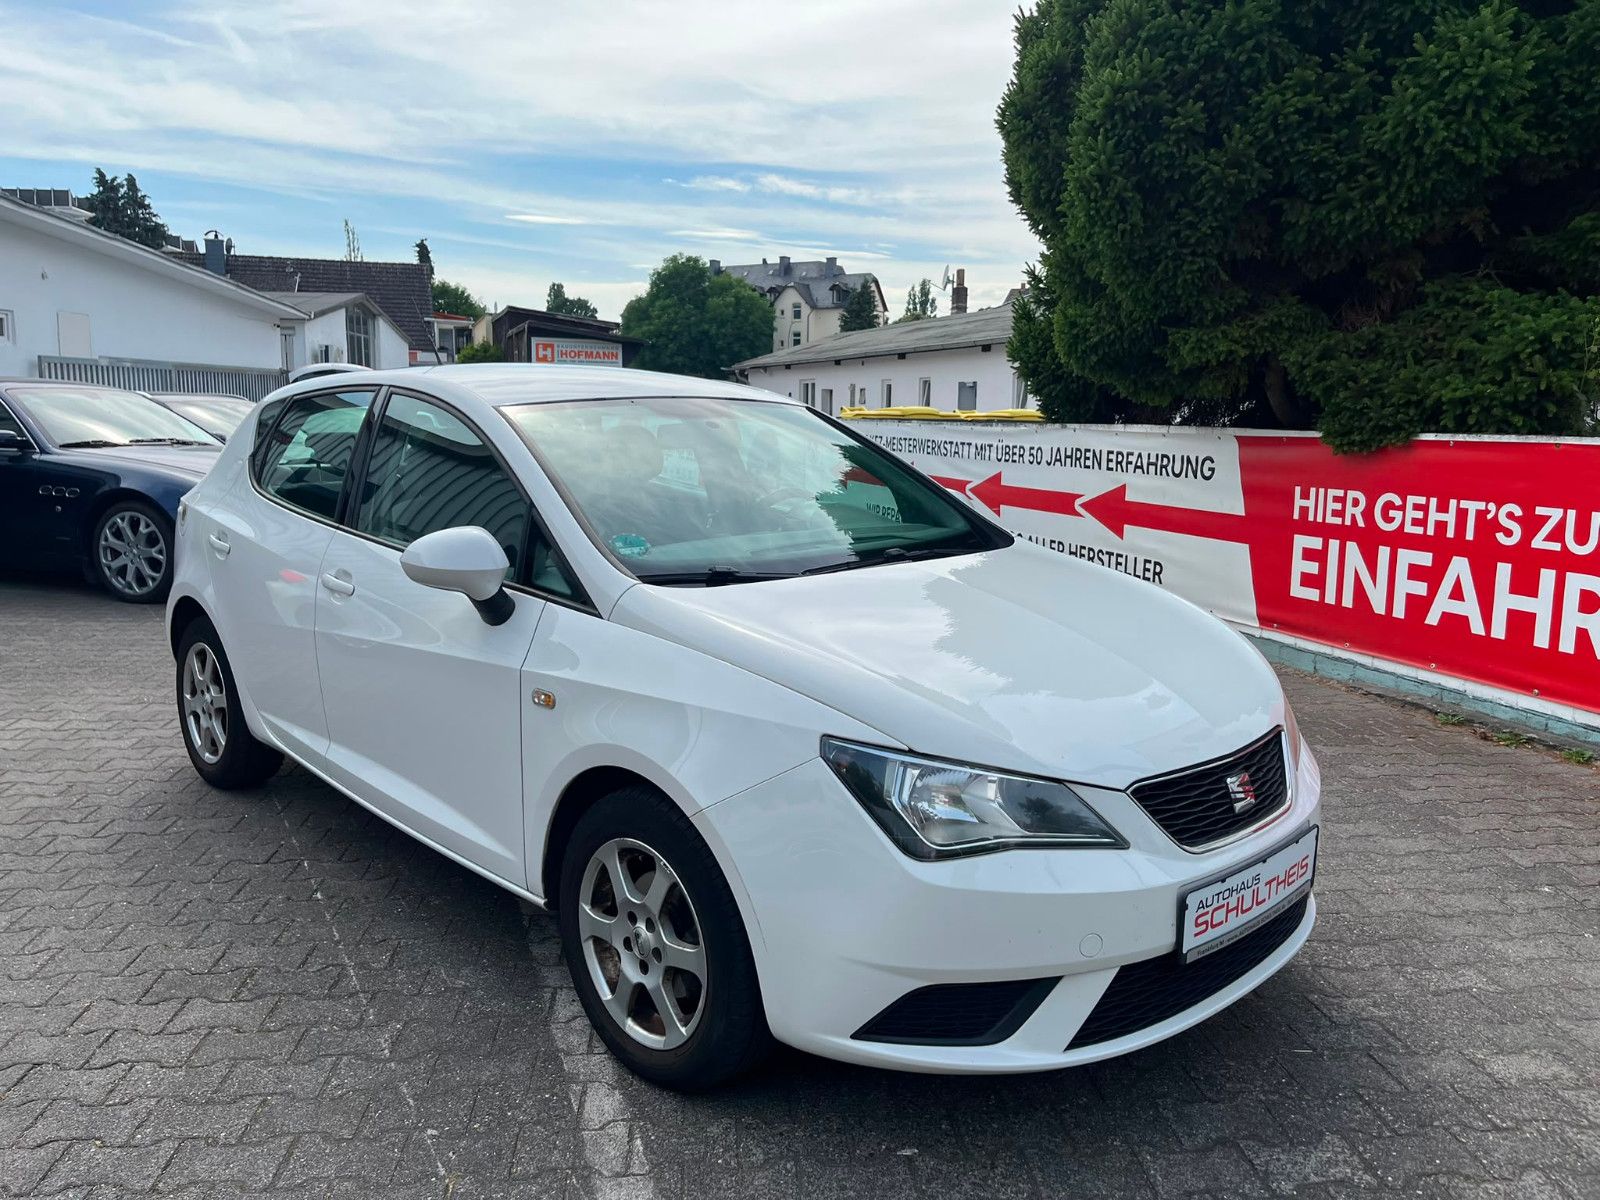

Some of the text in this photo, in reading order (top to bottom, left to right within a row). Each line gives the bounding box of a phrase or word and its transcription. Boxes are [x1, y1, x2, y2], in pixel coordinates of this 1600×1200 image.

[560, 350, 618, 361] HOFMANN
[974, 442, 994, 461] MIT
[996, 439, 1025, 464] ÜBER
[1028, 446, 1043, 466] 50
[1046, 446, 1102, 471] JAHREN
[1106, 449, 1216, 481] ERFAHRUNG
[1292, 485, 1600, 556] HIER GEHT'S ZU
[1068, 543, 1164, 585] HERSTELLER
[1289, 534, 1600, 661] EINFAHR
[1193, 854, 1310, 938] SCHULTHEIS
[1195, 873, 1261, 913] AUTOHAUS
